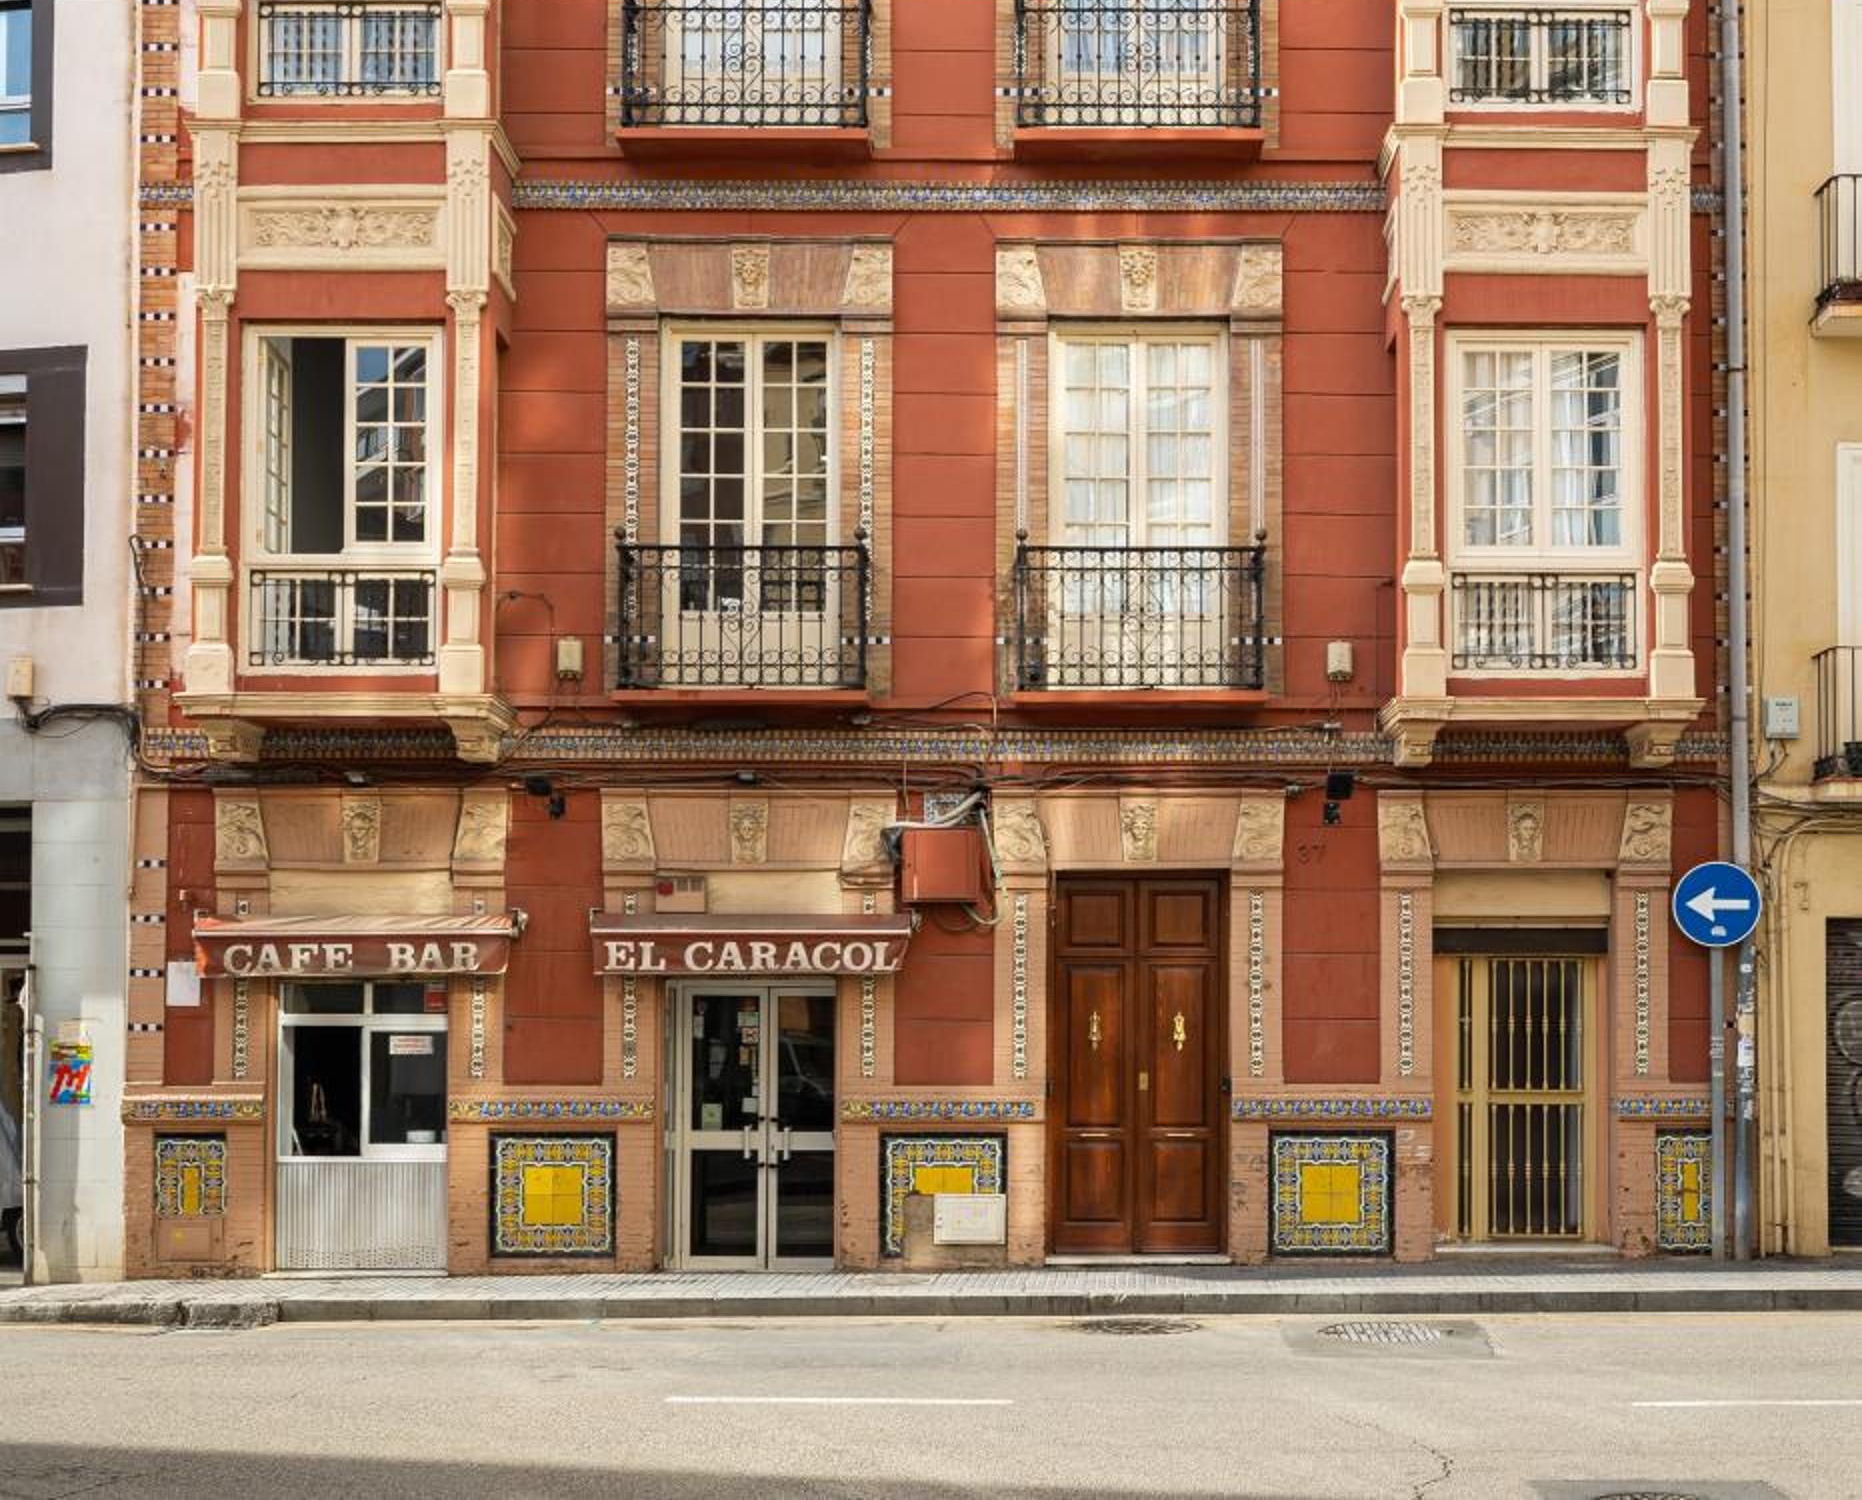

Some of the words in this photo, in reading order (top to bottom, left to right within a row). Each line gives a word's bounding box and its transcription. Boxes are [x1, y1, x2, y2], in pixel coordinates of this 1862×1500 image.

[223, 943, 353, 975] CAFE
[386, 941, 480, 973] BAR
[603, 940, 667, 972] EL
[684, 940, 899, 972] CARACOL
